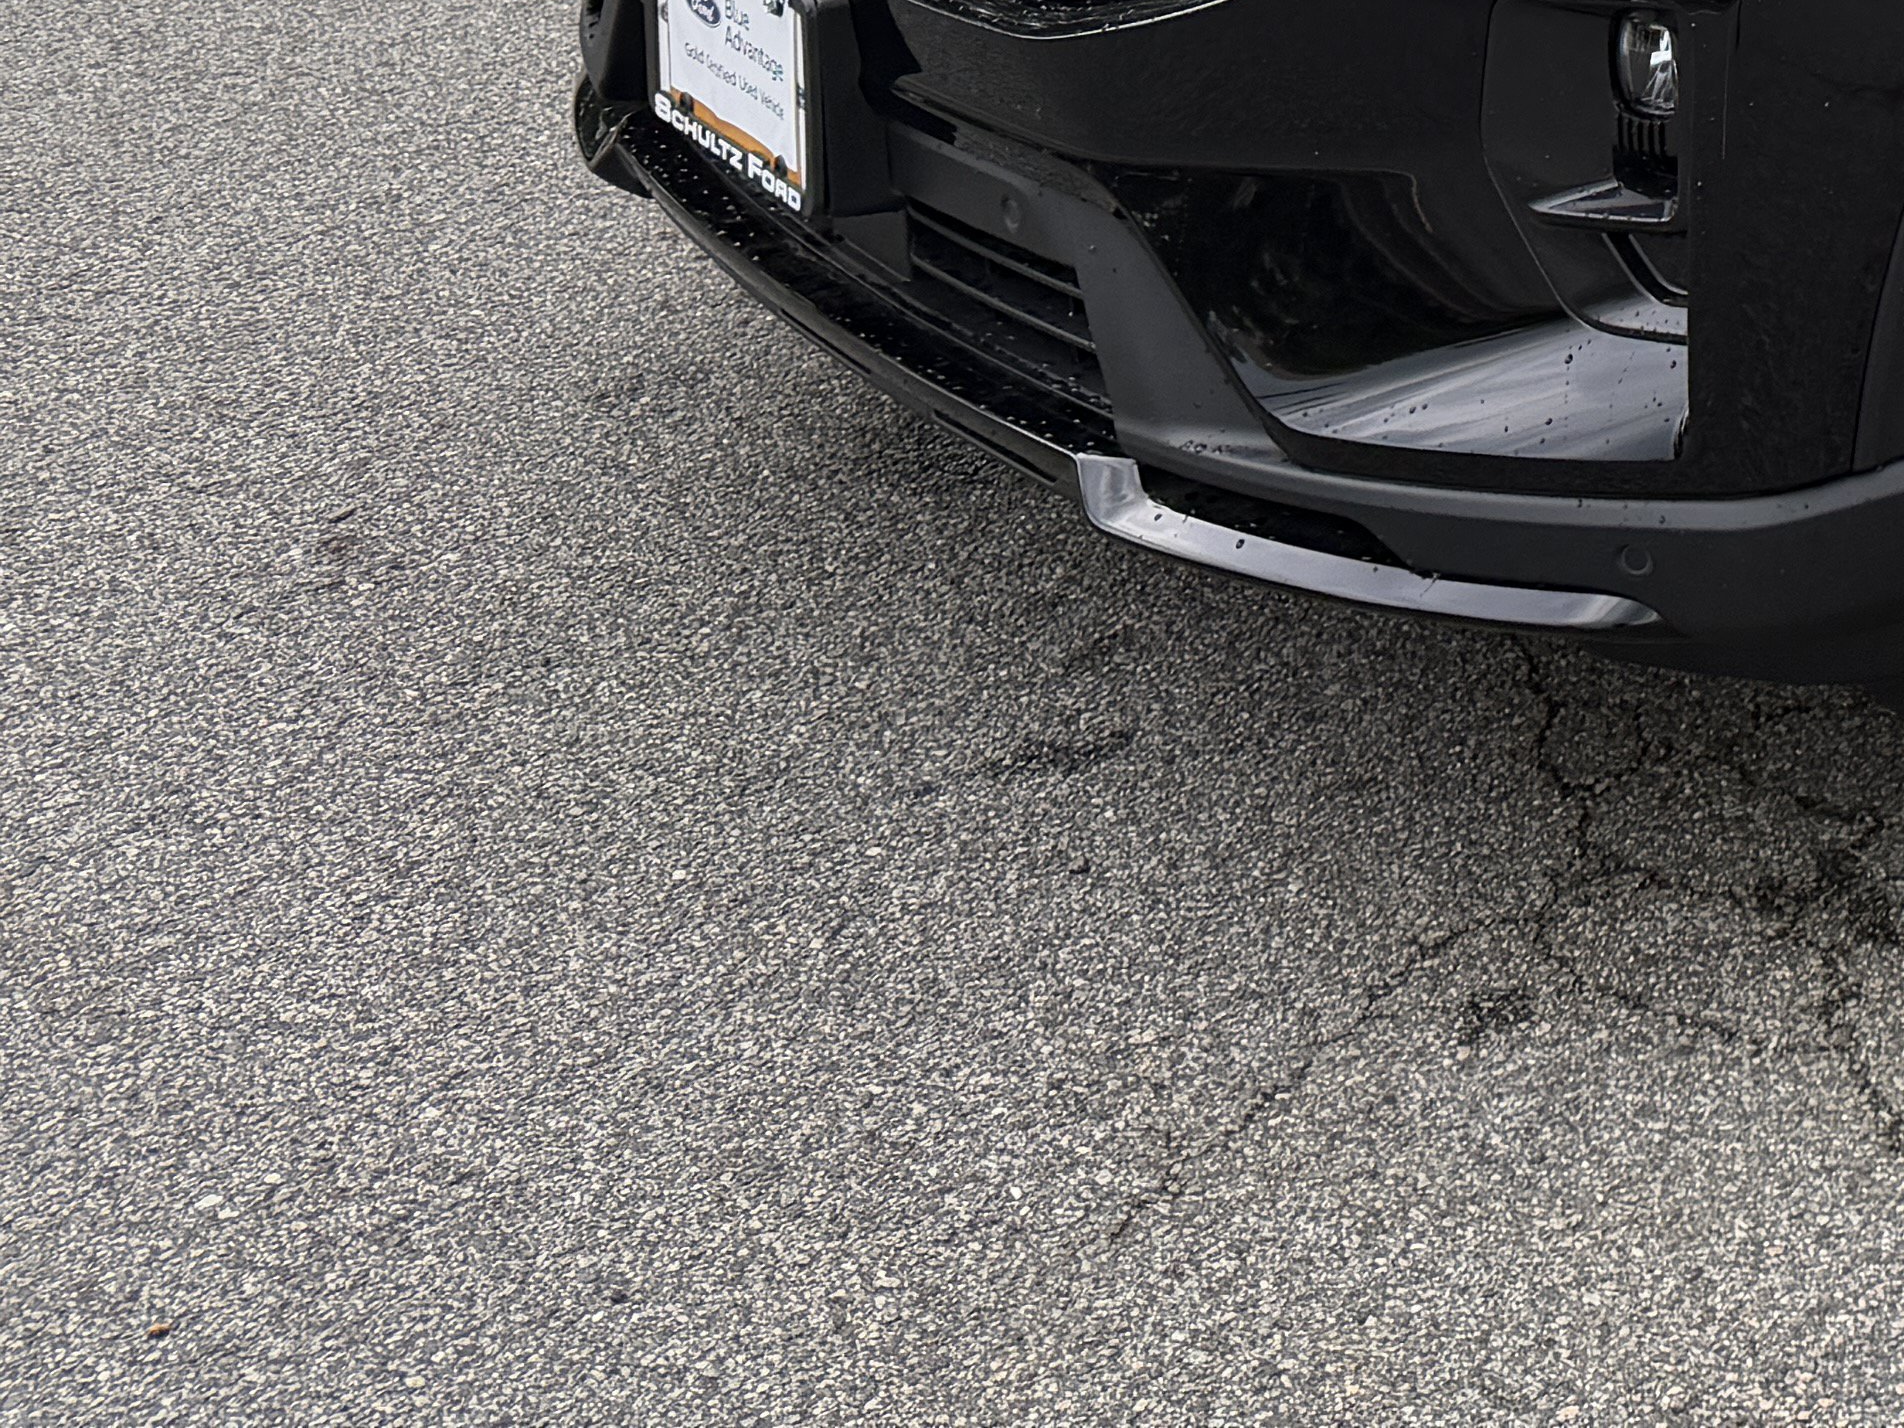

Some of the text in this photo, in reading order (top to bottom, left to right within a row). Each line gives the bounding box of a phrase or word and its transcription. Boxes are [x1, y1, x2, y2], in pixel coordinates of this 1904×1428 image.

[725, 25, 784, 82] Advantage
[739, 75, 758, 101] Used
[654, 92, 802, 213] SCHULTZ FORD
